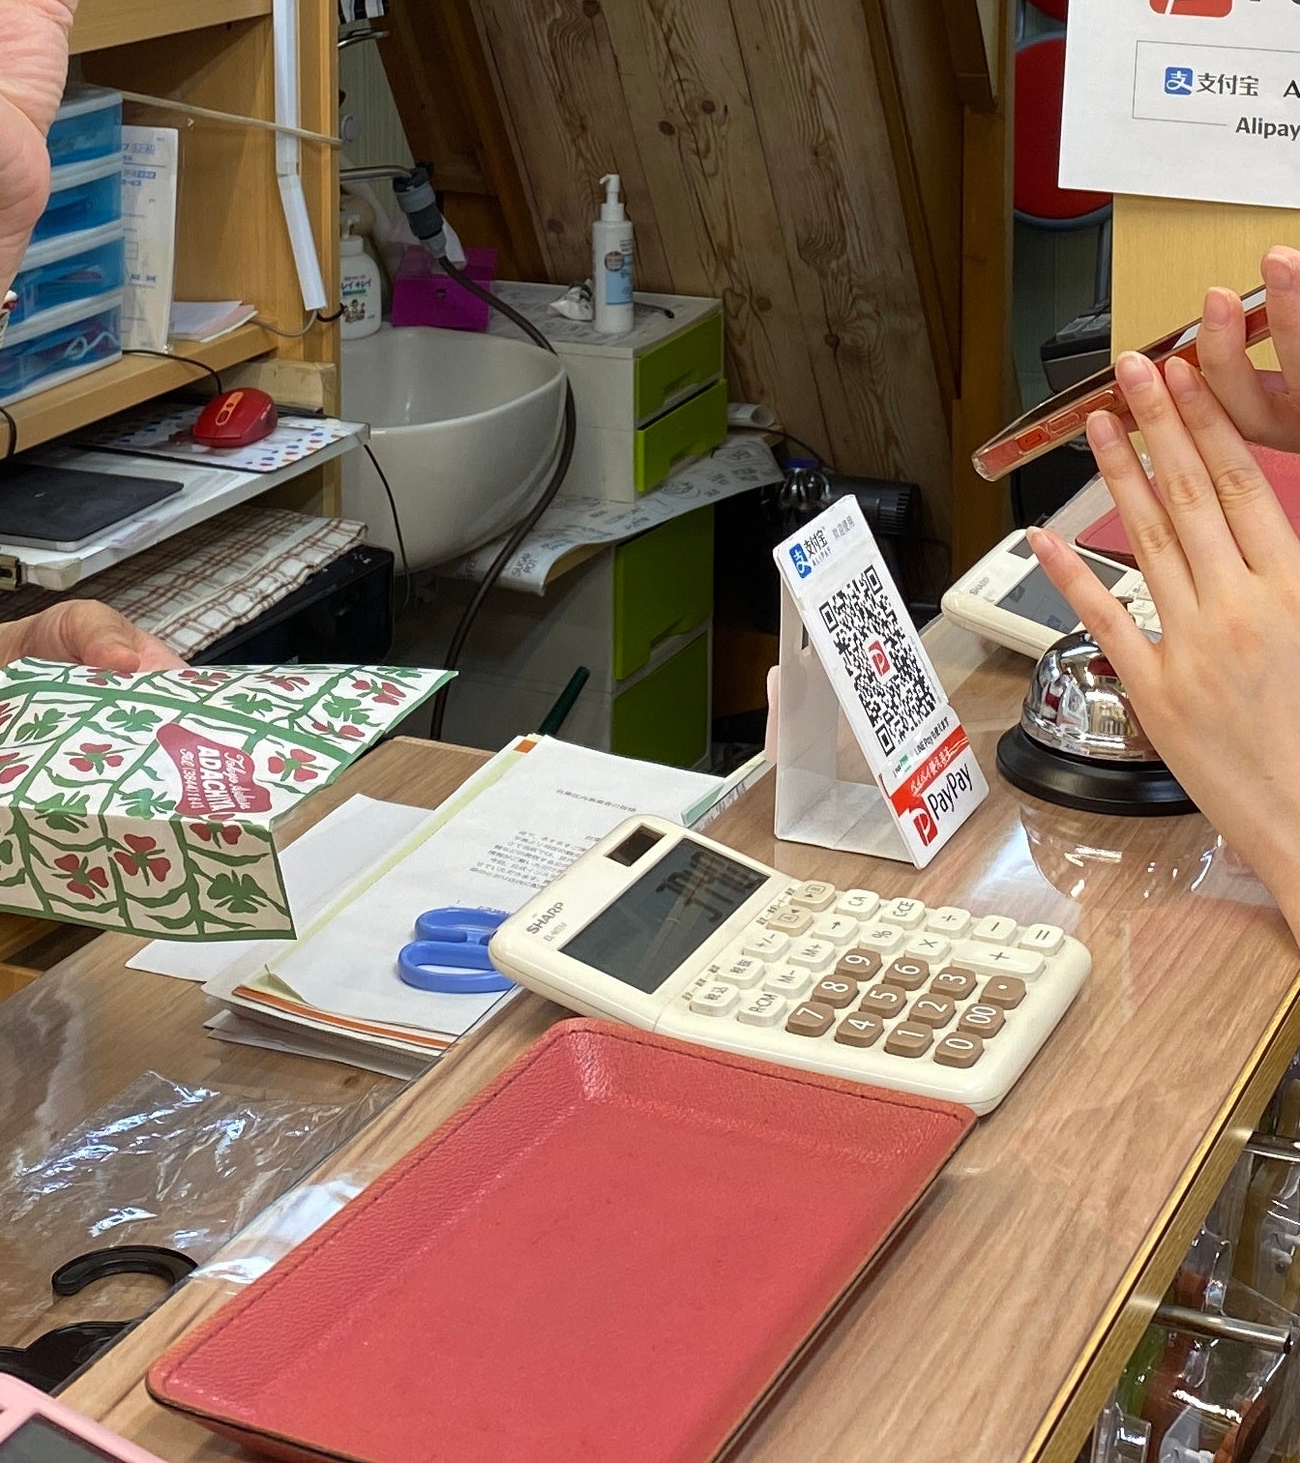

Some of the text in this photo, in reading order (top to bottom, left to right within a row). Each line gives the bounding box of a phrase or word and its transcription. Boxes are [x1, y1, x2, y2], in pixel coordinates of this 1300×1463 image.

[1196, 72, 1260, 97] 支付宝
[804, 528, 829, 559] 支付宝
[197, 744, 236, 812] ADACHIYA
[927, 762, 972, 821] PayPay
[847, 895, 868, 909] CA
[526, 902, 565, 935] SHARP
[800, 942, 823, 958] M+
[844, 954, 871, 967] 9
[895, 963, 921, 976] 6
[939, 972, 967, 986] 3
[829, 981, 851, 994] 8
[869, 989, 898, 1003] 5
[917, 999, 948, 1013] 2
[798, 1006, 826, 1021] 7
[965, 1005, 997, 1025] 00
[847, 1015, 873, 1030] 4
[897, 1028, 926, 1039] 1
[945, 1038, 975, 1050] 0
